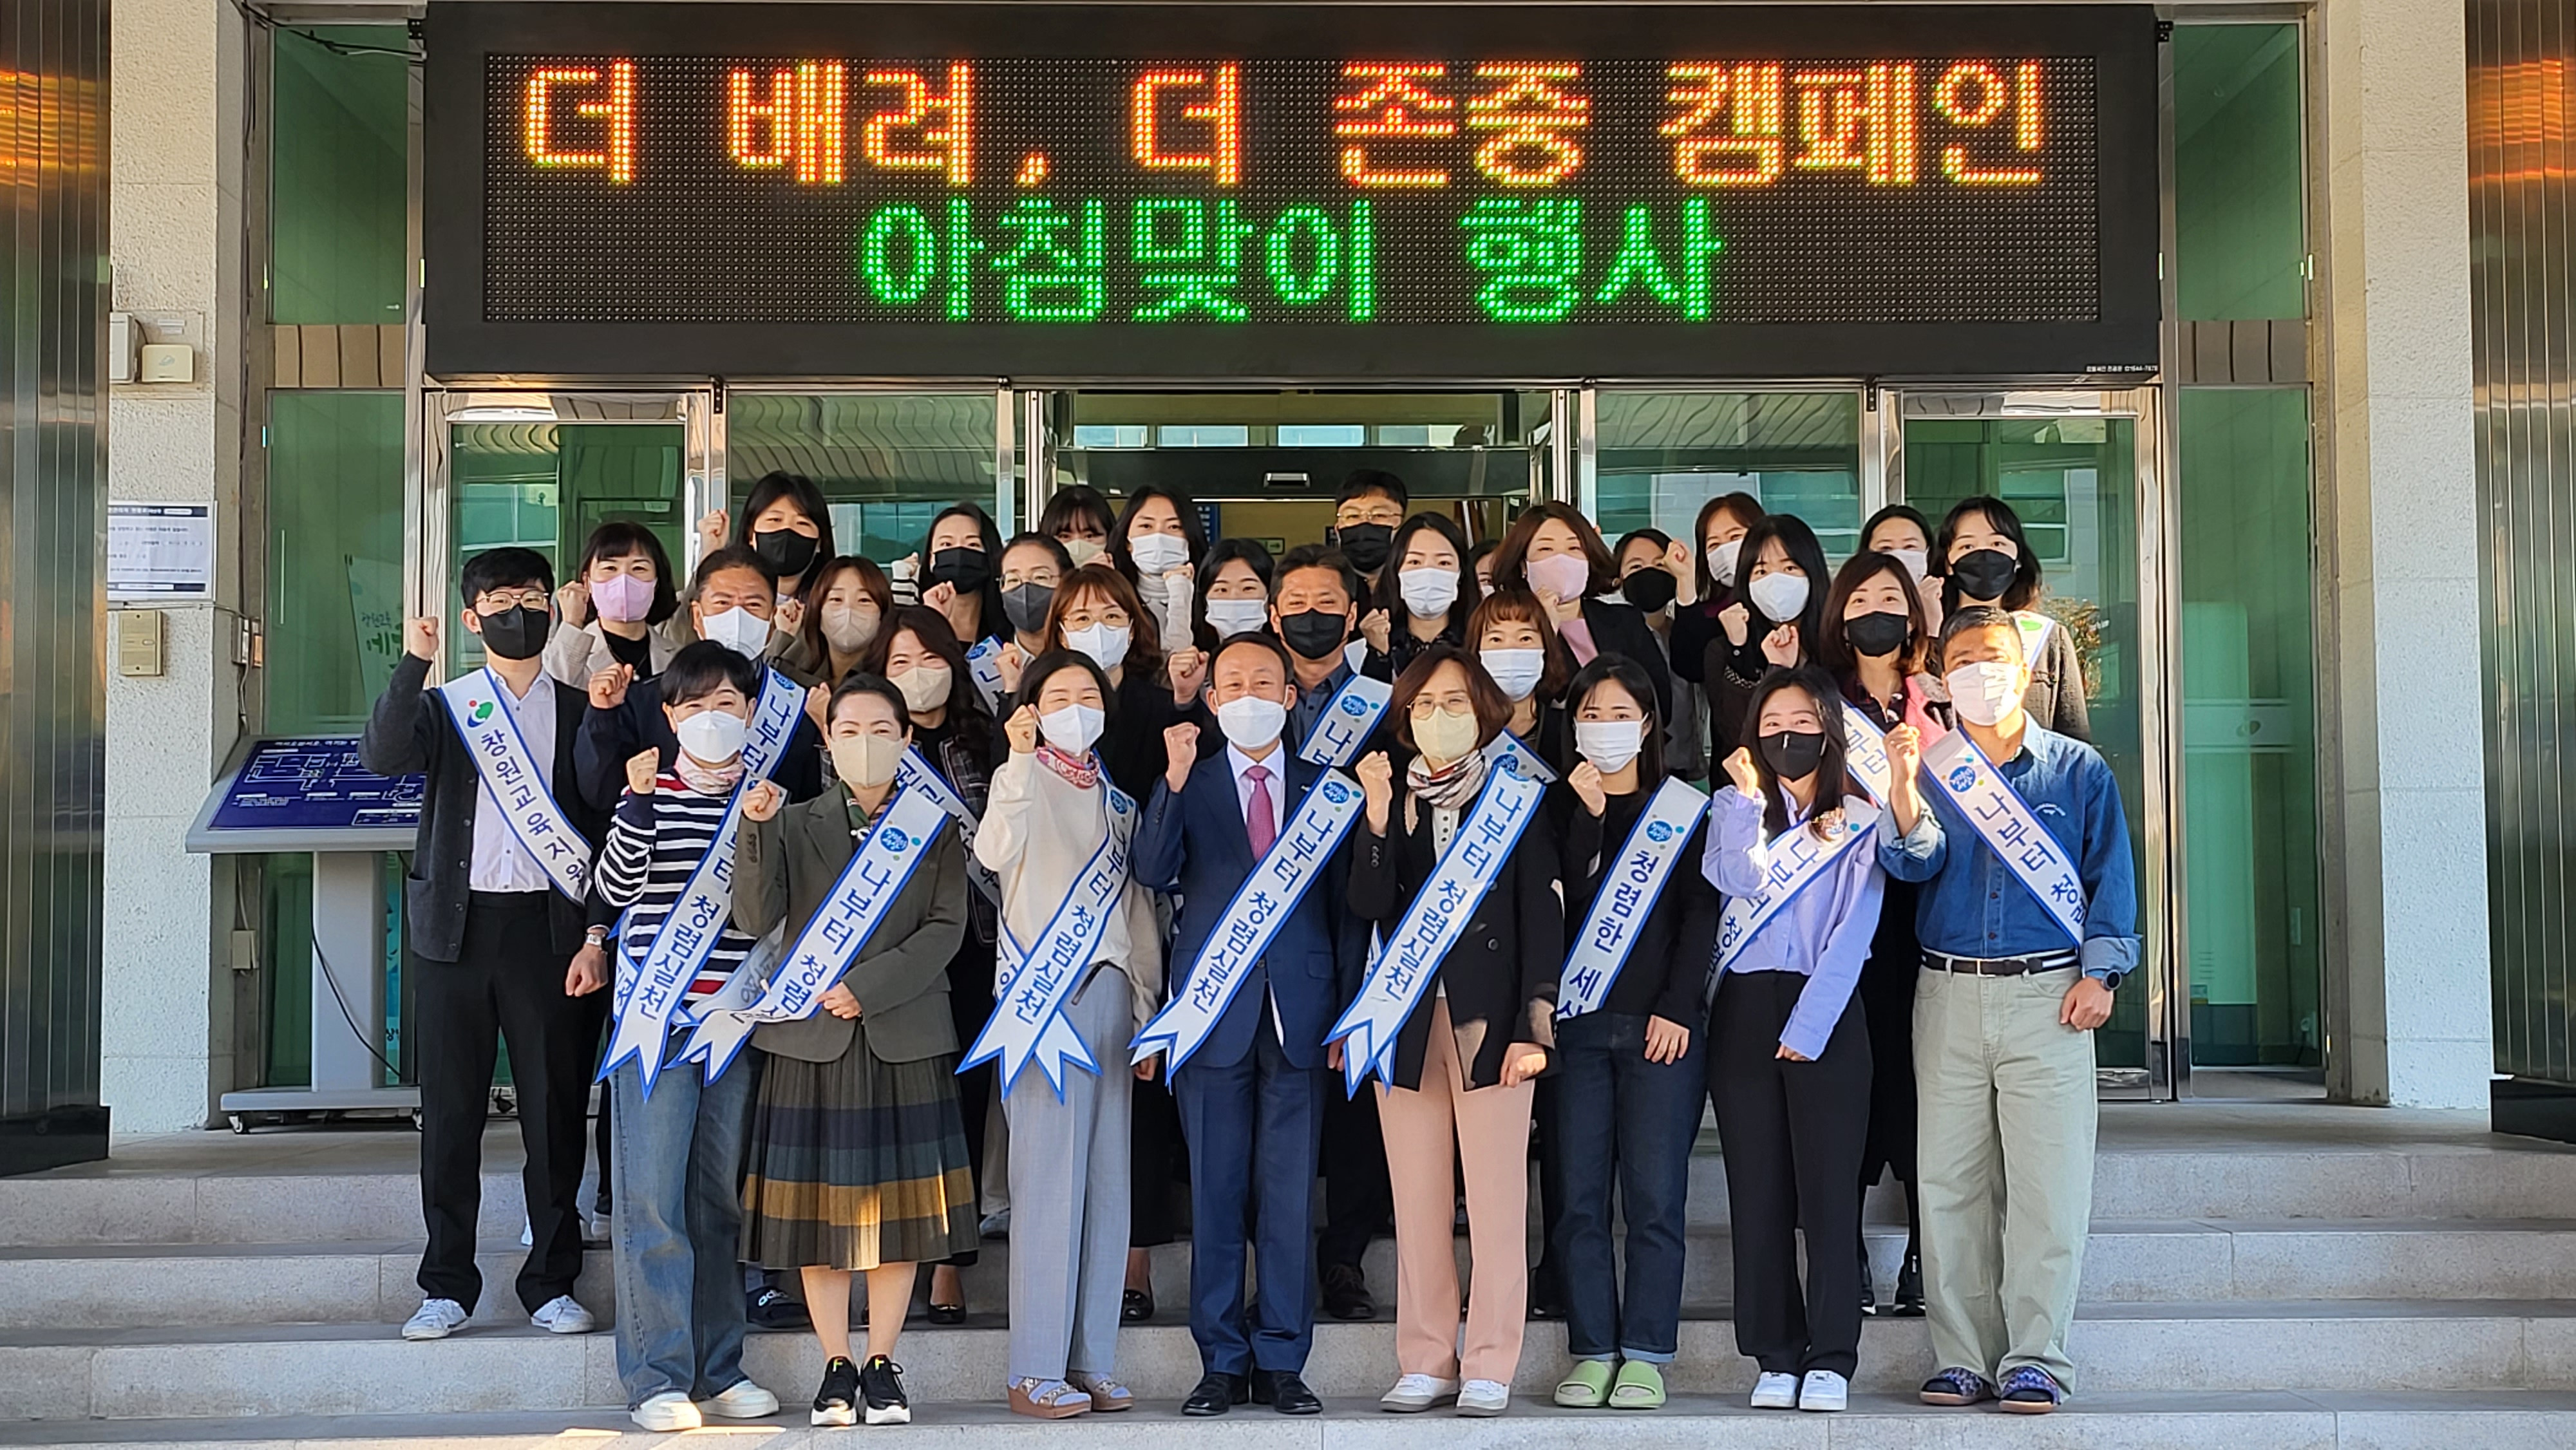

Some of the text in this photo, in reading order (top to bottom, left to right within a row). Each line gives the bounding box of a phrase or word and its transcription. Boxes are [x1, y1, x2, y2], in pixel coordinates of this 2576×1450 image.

[525, 59, 2043, 187] 더 배려, 더 존중 캠페인
[862, 198, 1722, 321] 아침맞이 행사
[742, 693, 792, 774] 나부터
[1845, 719, 1888, 775] 부터
[1461, 787, 1524, 880] 나부터
[1974, 791, 2058, 871] 나부터
[638, 894, 721, 1021] 청렴실천
[822, 859, 892, 956] 나부터
[1015, 822, 1127, 1025] 나부터 청렴실천
[1193, 809, 1334, 1014] 나부터 청렴실천
[1385, 878, 1468, 1001] 청렴실천
[1594, 849, 1660, 954] 청렴한
